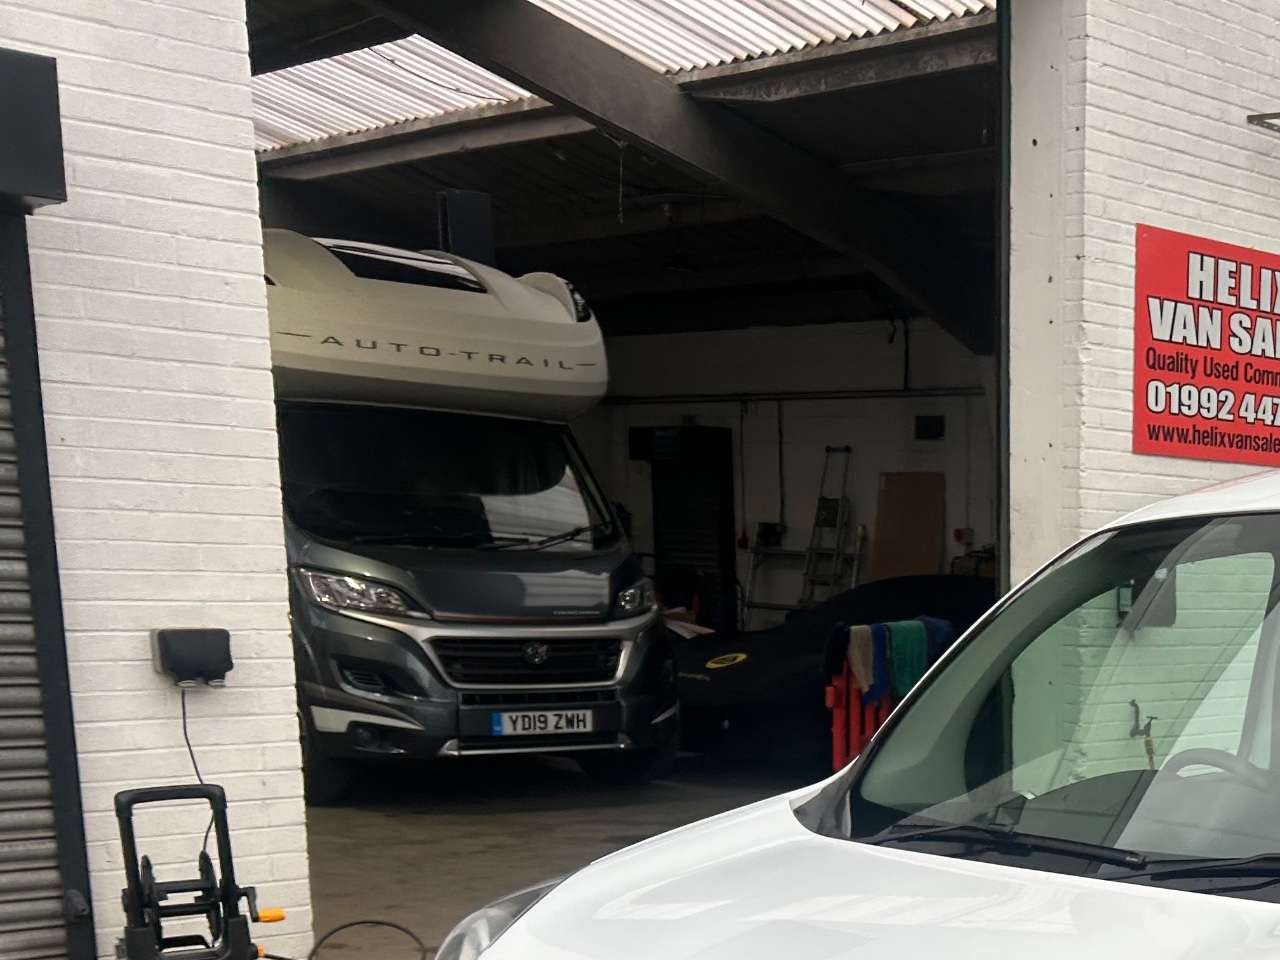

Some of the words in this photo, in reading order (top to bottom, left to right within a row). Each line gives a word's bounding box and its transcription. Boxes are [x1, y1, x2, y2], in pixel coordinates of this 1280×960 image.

[1147, 296, 1222, 350] VAN
[321, 335, 574, 370] AUTO-TRAIL
[1146, 347, 1198, 379] Quality
[1203, 357, 1239, 382] Used
[1146, 379, 1235, 421] 01992
[508, 714, 548, 731] YD19
[553, 713, 587, 730] ZWH
